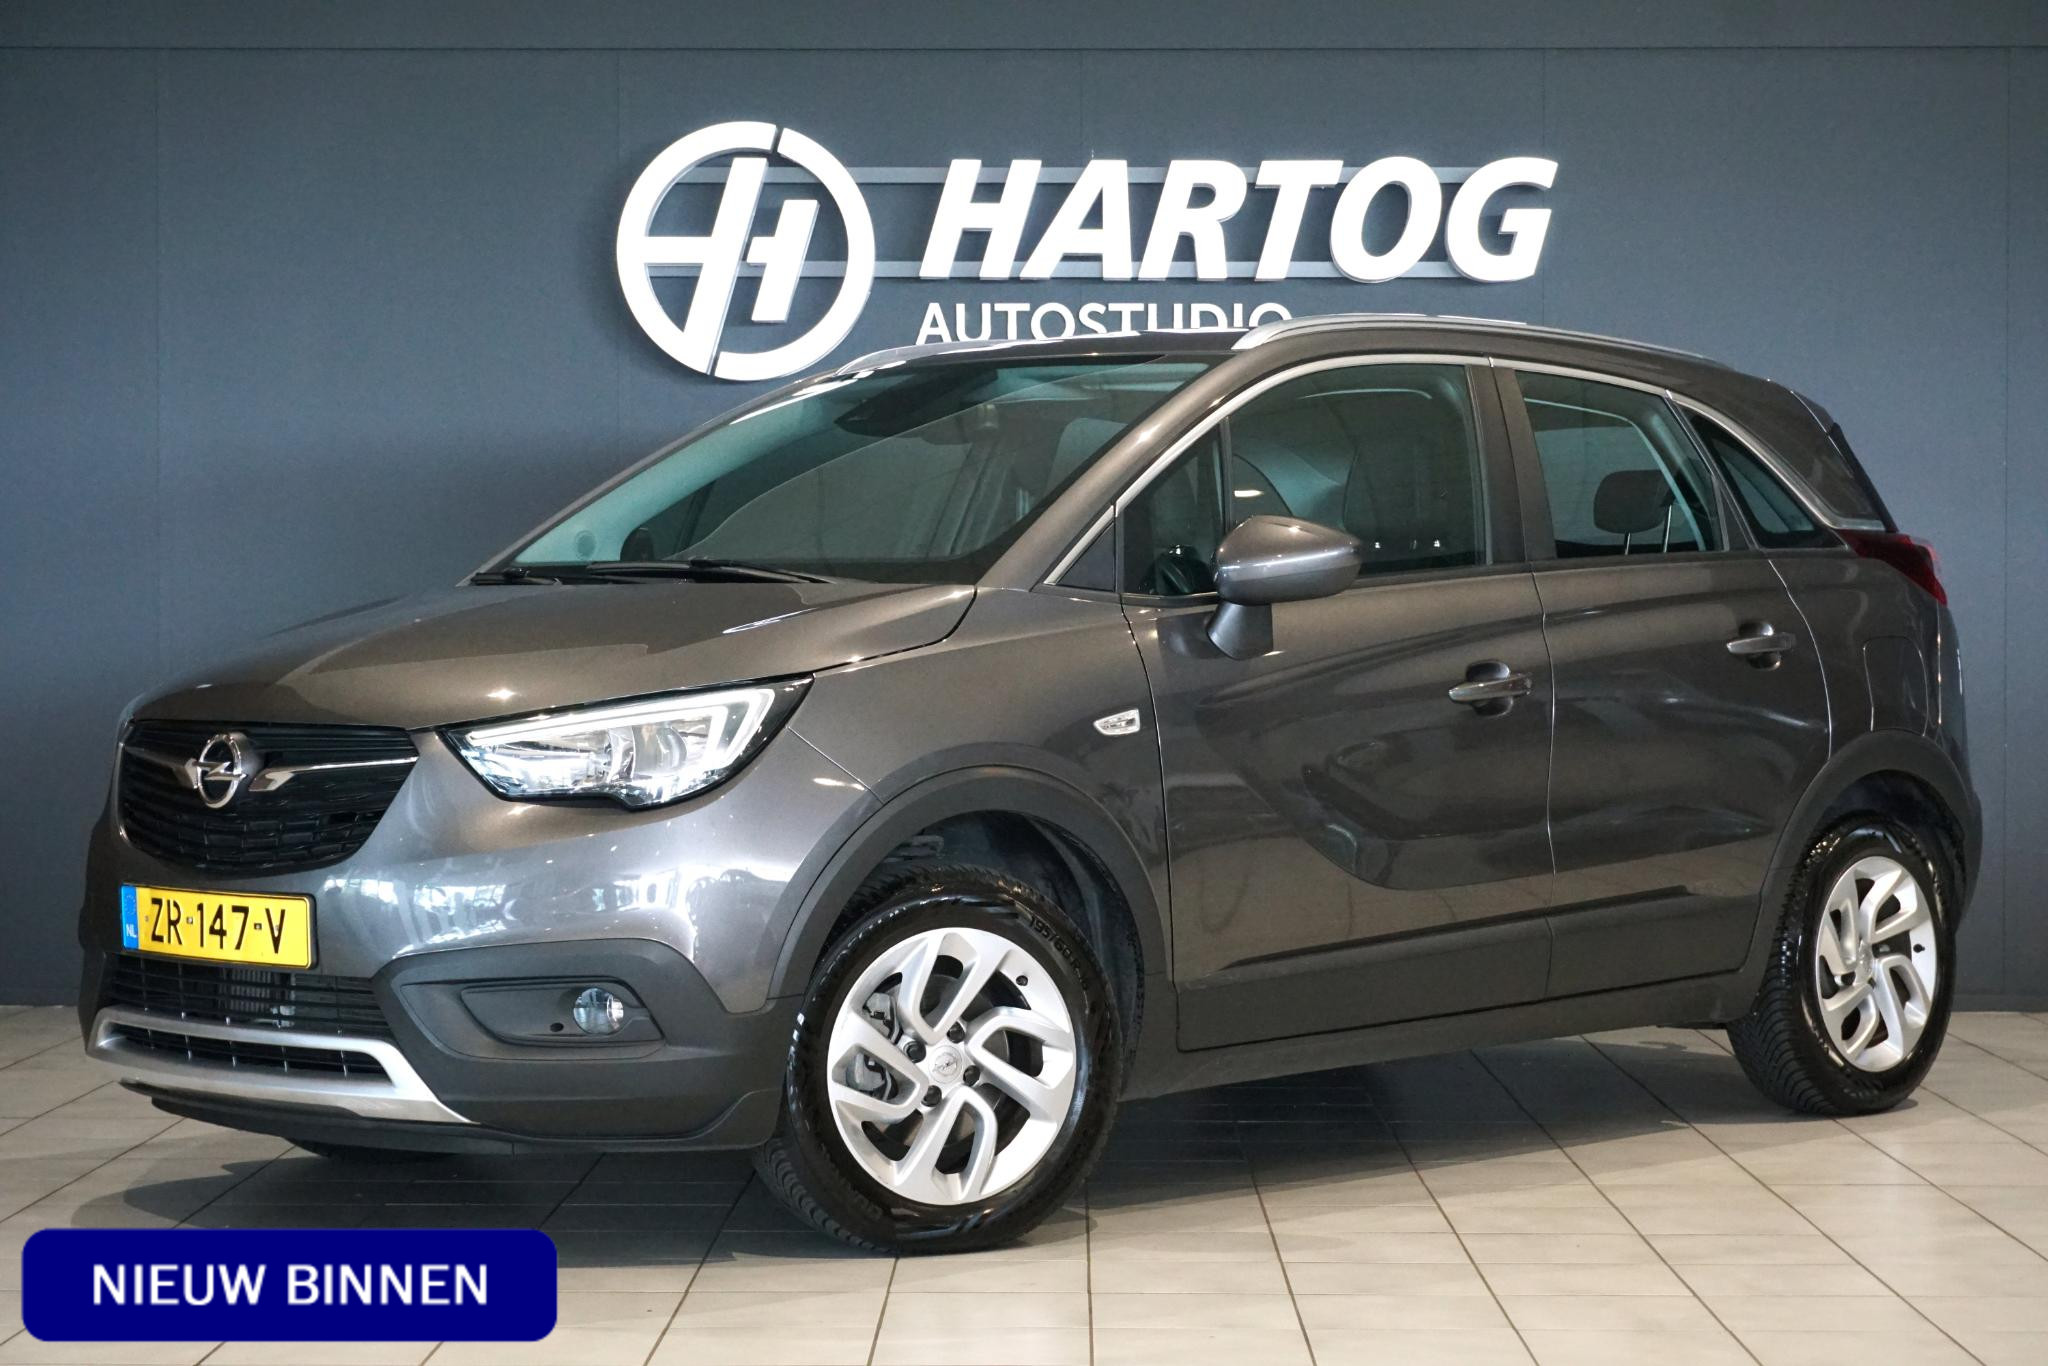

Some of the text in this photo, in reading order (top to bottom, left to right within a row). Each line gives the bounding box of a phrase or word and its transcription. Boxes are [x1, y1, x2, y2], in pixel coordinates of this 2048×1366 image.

[920, 155, 1559, 284] HARTOG
[126, 924, 137, 938] NL
[151, 898, 286, 954] ZR-147-V
